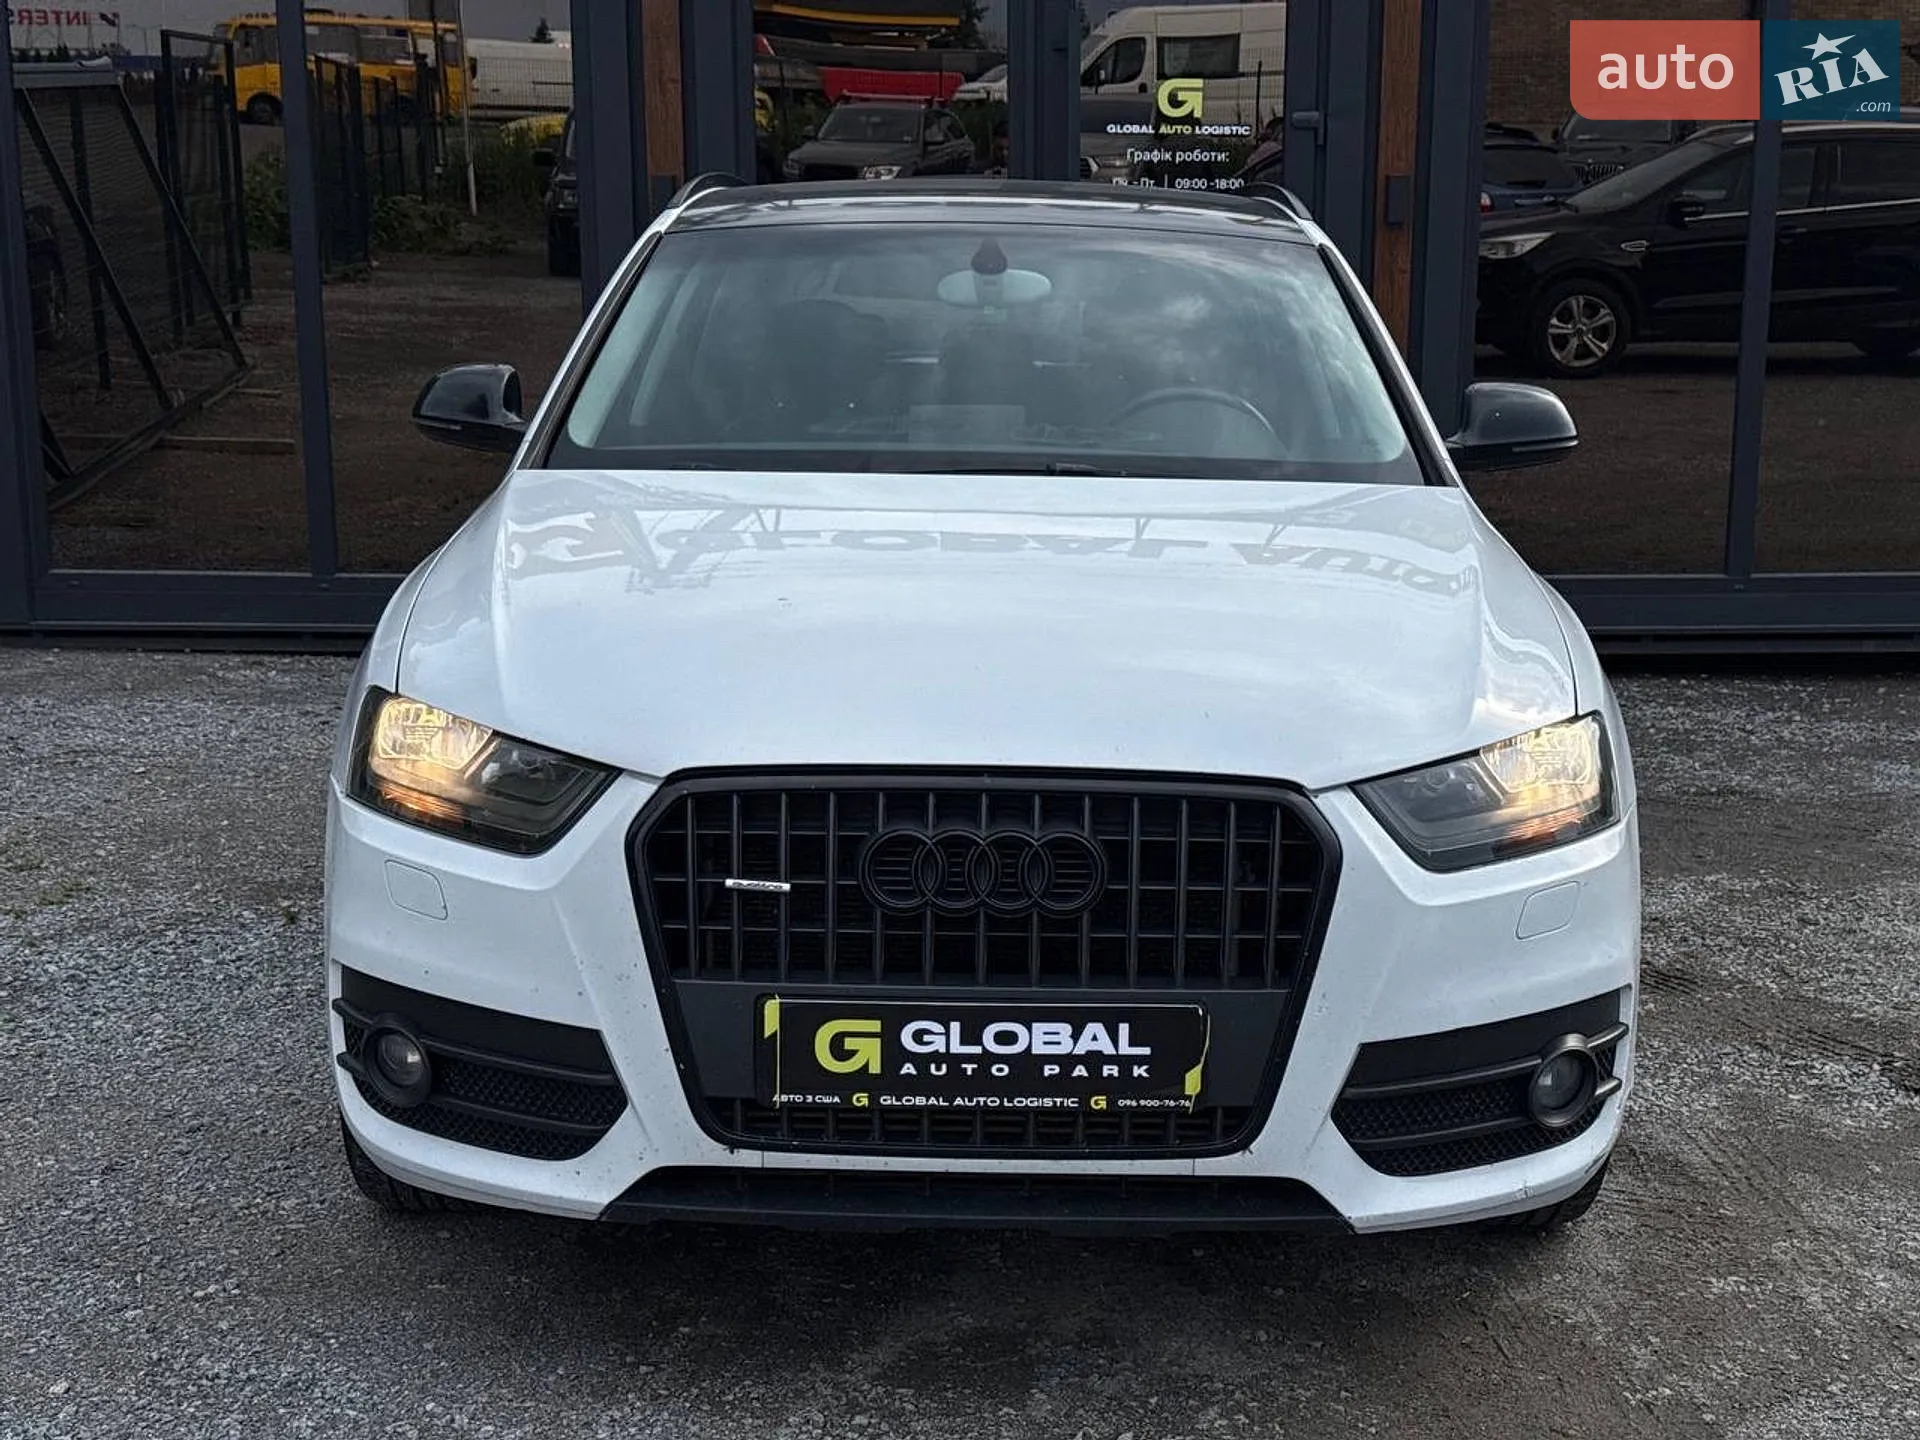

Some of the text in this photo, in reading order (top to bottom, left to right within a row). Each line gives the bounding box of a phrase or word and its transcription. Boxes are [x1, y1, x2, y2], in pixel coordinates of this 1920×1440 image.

[1106, 123, 1251, 135] GLOBAL AUTO LOGISTIC
[1126, 149, 1230, 163] Графік роботи:
[900, 1020, 1152, 1056] GLOBAL
[900, 1063, 1151, 1078] AUTO PARK
[880, 1095, 1079, 1108] GLOBAL AUTO LOGISTIC
